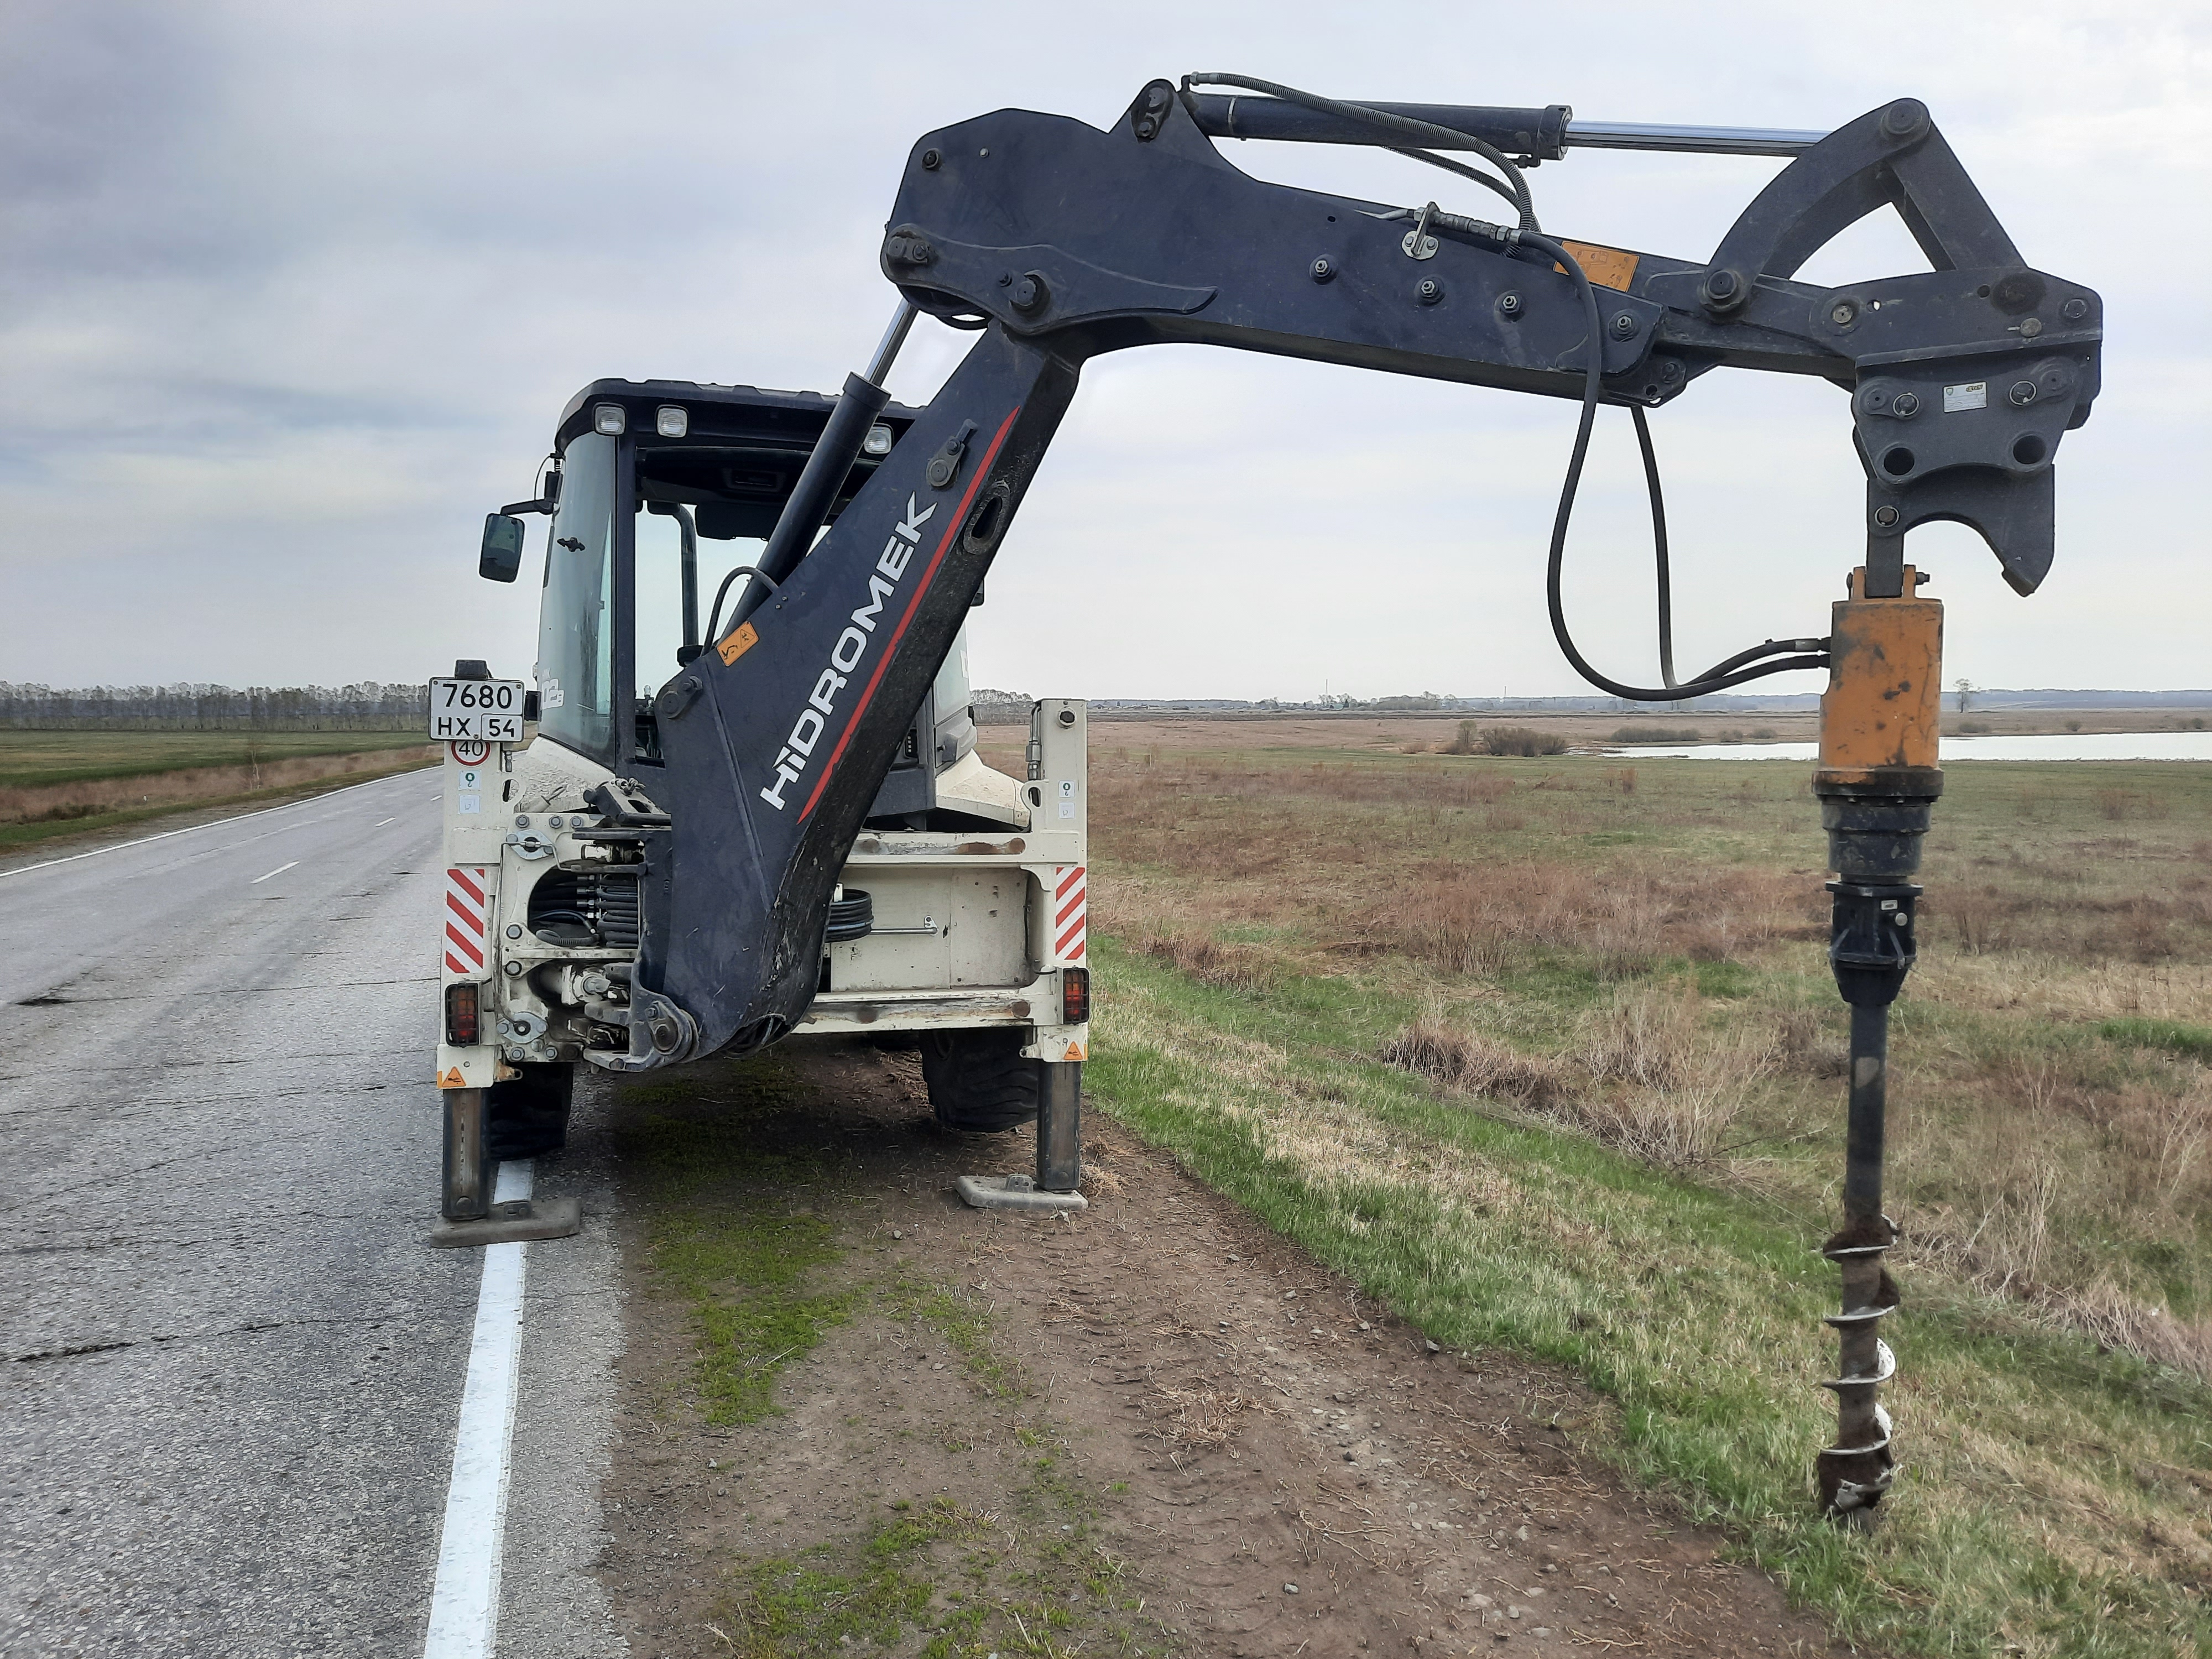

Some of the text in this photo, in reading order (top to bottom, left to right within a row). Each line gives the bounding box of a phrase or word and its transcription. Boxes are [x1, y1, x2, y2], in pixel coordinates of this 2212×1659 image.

[442, 683, 512, 709] 7680
[489, 718, 515, 737] 54
[458, 740, 483, 757] 40
